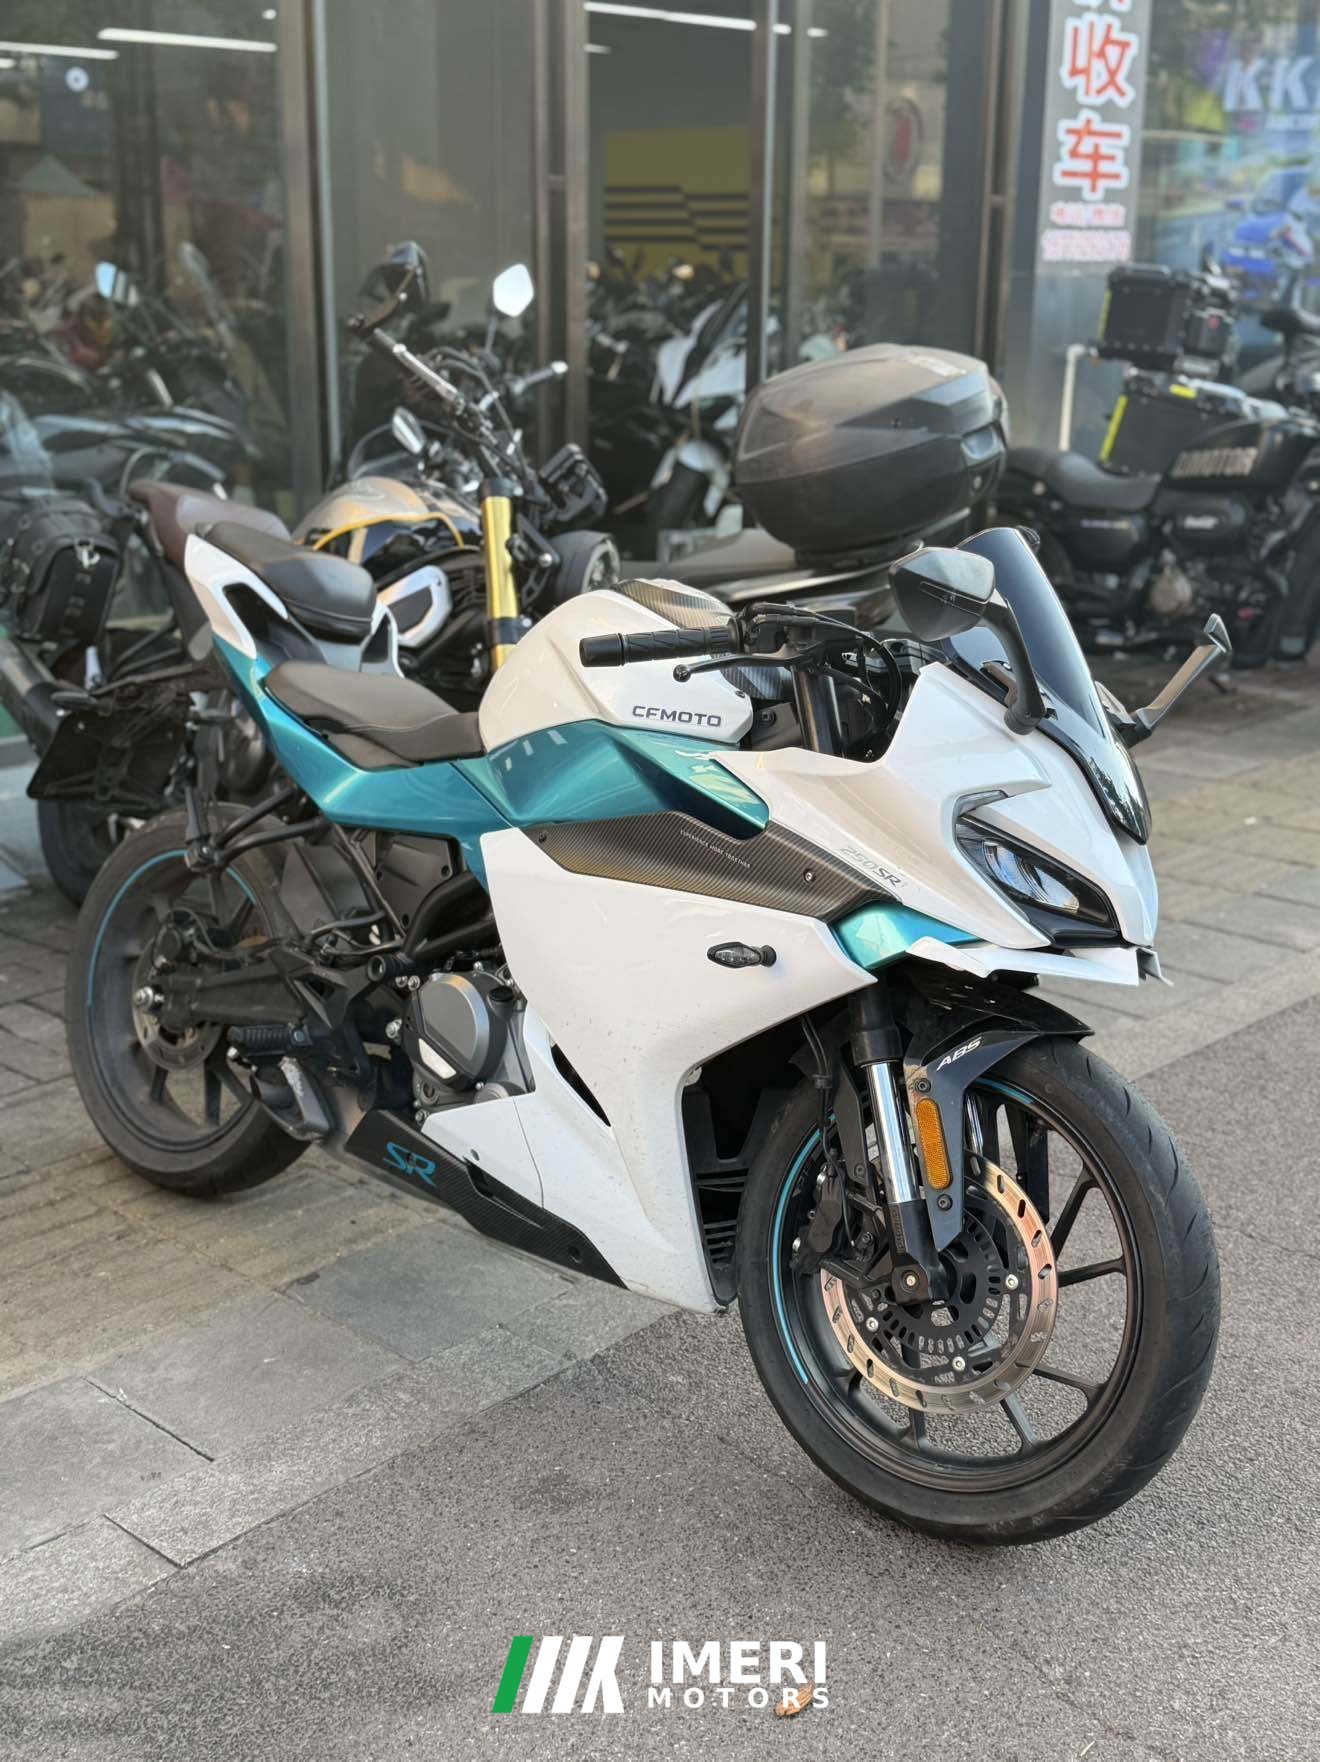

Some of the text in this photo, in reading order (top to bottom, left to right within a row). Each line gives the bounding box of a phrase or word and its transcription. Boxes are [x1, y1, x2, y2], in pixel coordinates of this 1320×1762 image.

[1058, 0, 1135, 197] 收车
[632, 705, 722, 727] CFMOTO
[936, 1036, 983, 1071] ABS
[382, 1141, 437, 1187] SR
